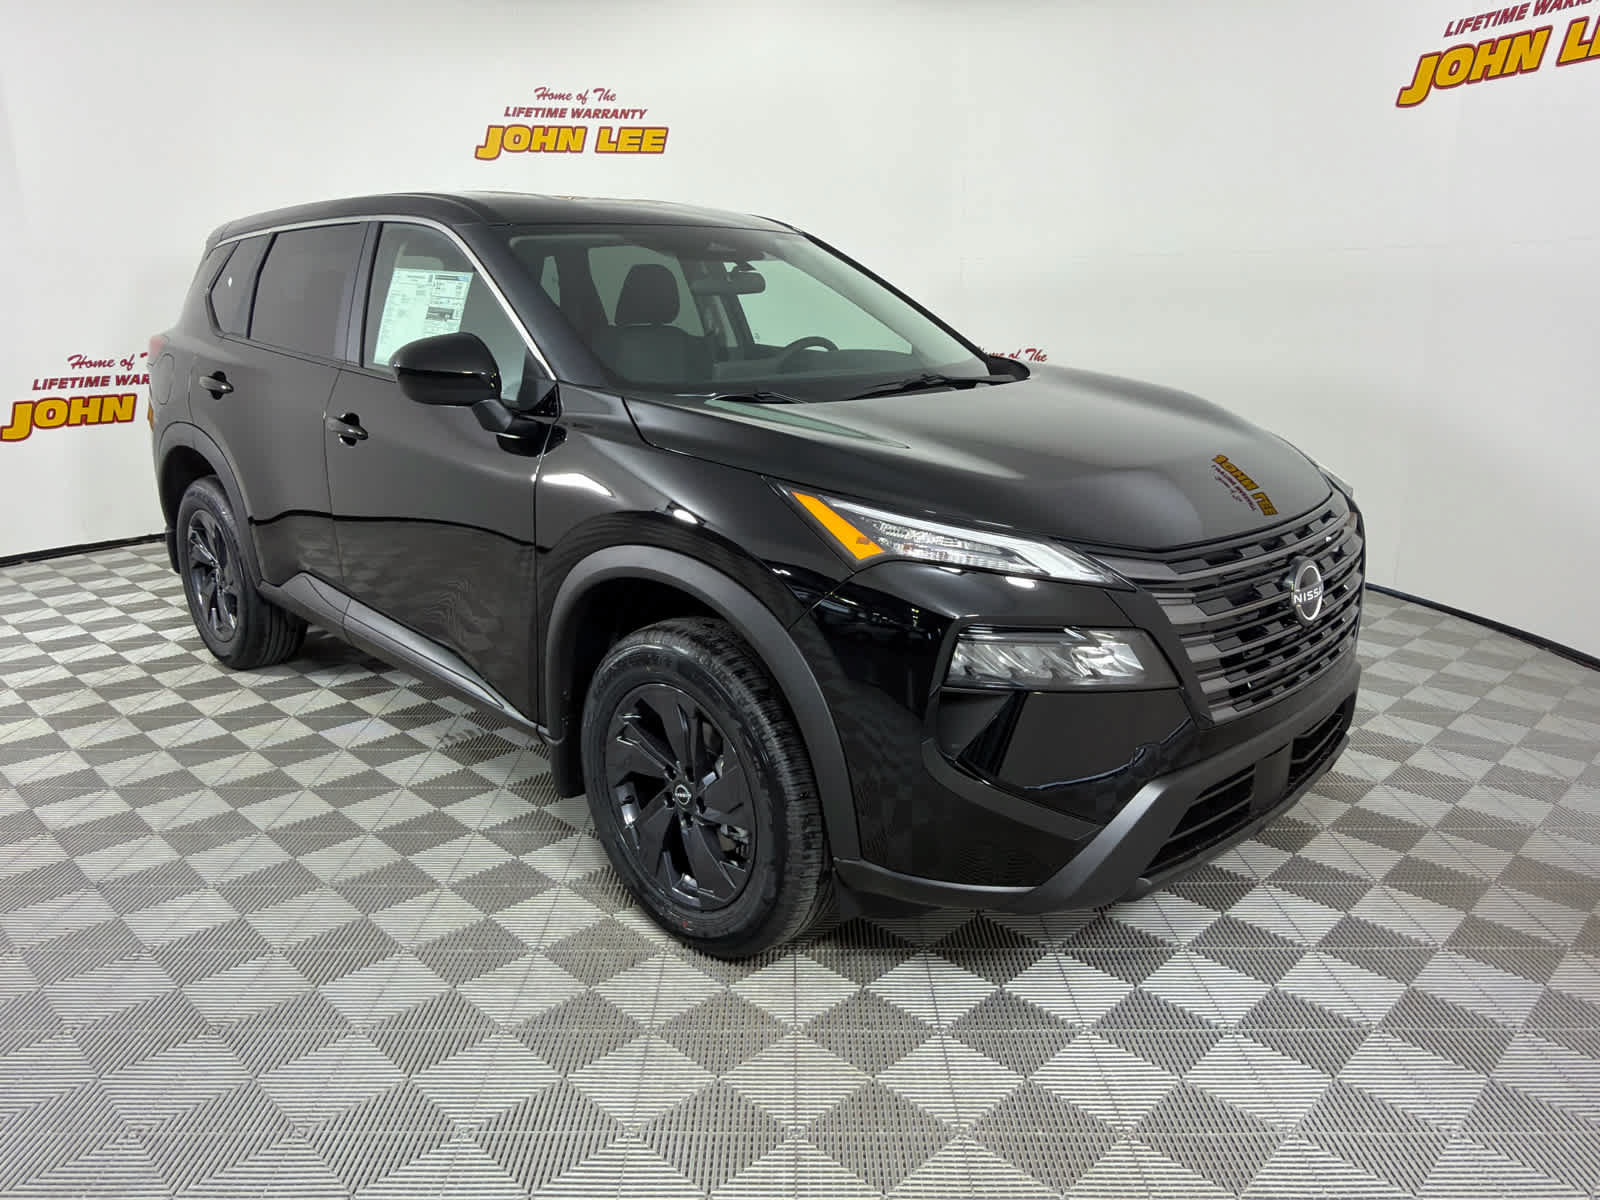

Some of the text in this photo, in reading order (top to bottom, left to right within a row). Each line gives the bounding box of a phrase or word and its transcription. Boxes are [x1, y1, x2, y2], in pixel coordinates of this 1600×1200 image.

[1443, 2, 1531, 37] LIFETIME
[1395, 25, 1553, 108] JOHN
[534, 87, 617, 104] Home of The
[504, 106, 648, 120] LIFETIME WARRANTY
[474, 124, 669, 160] JOHN LEE
[67, 354, 115, 369] Home
[119, 353, 135, 371] of
[1025, 347, 1048, 362] The
[32, 375, 111, 391] LIFETIME
[0, 393, 138, 443] JOHN
